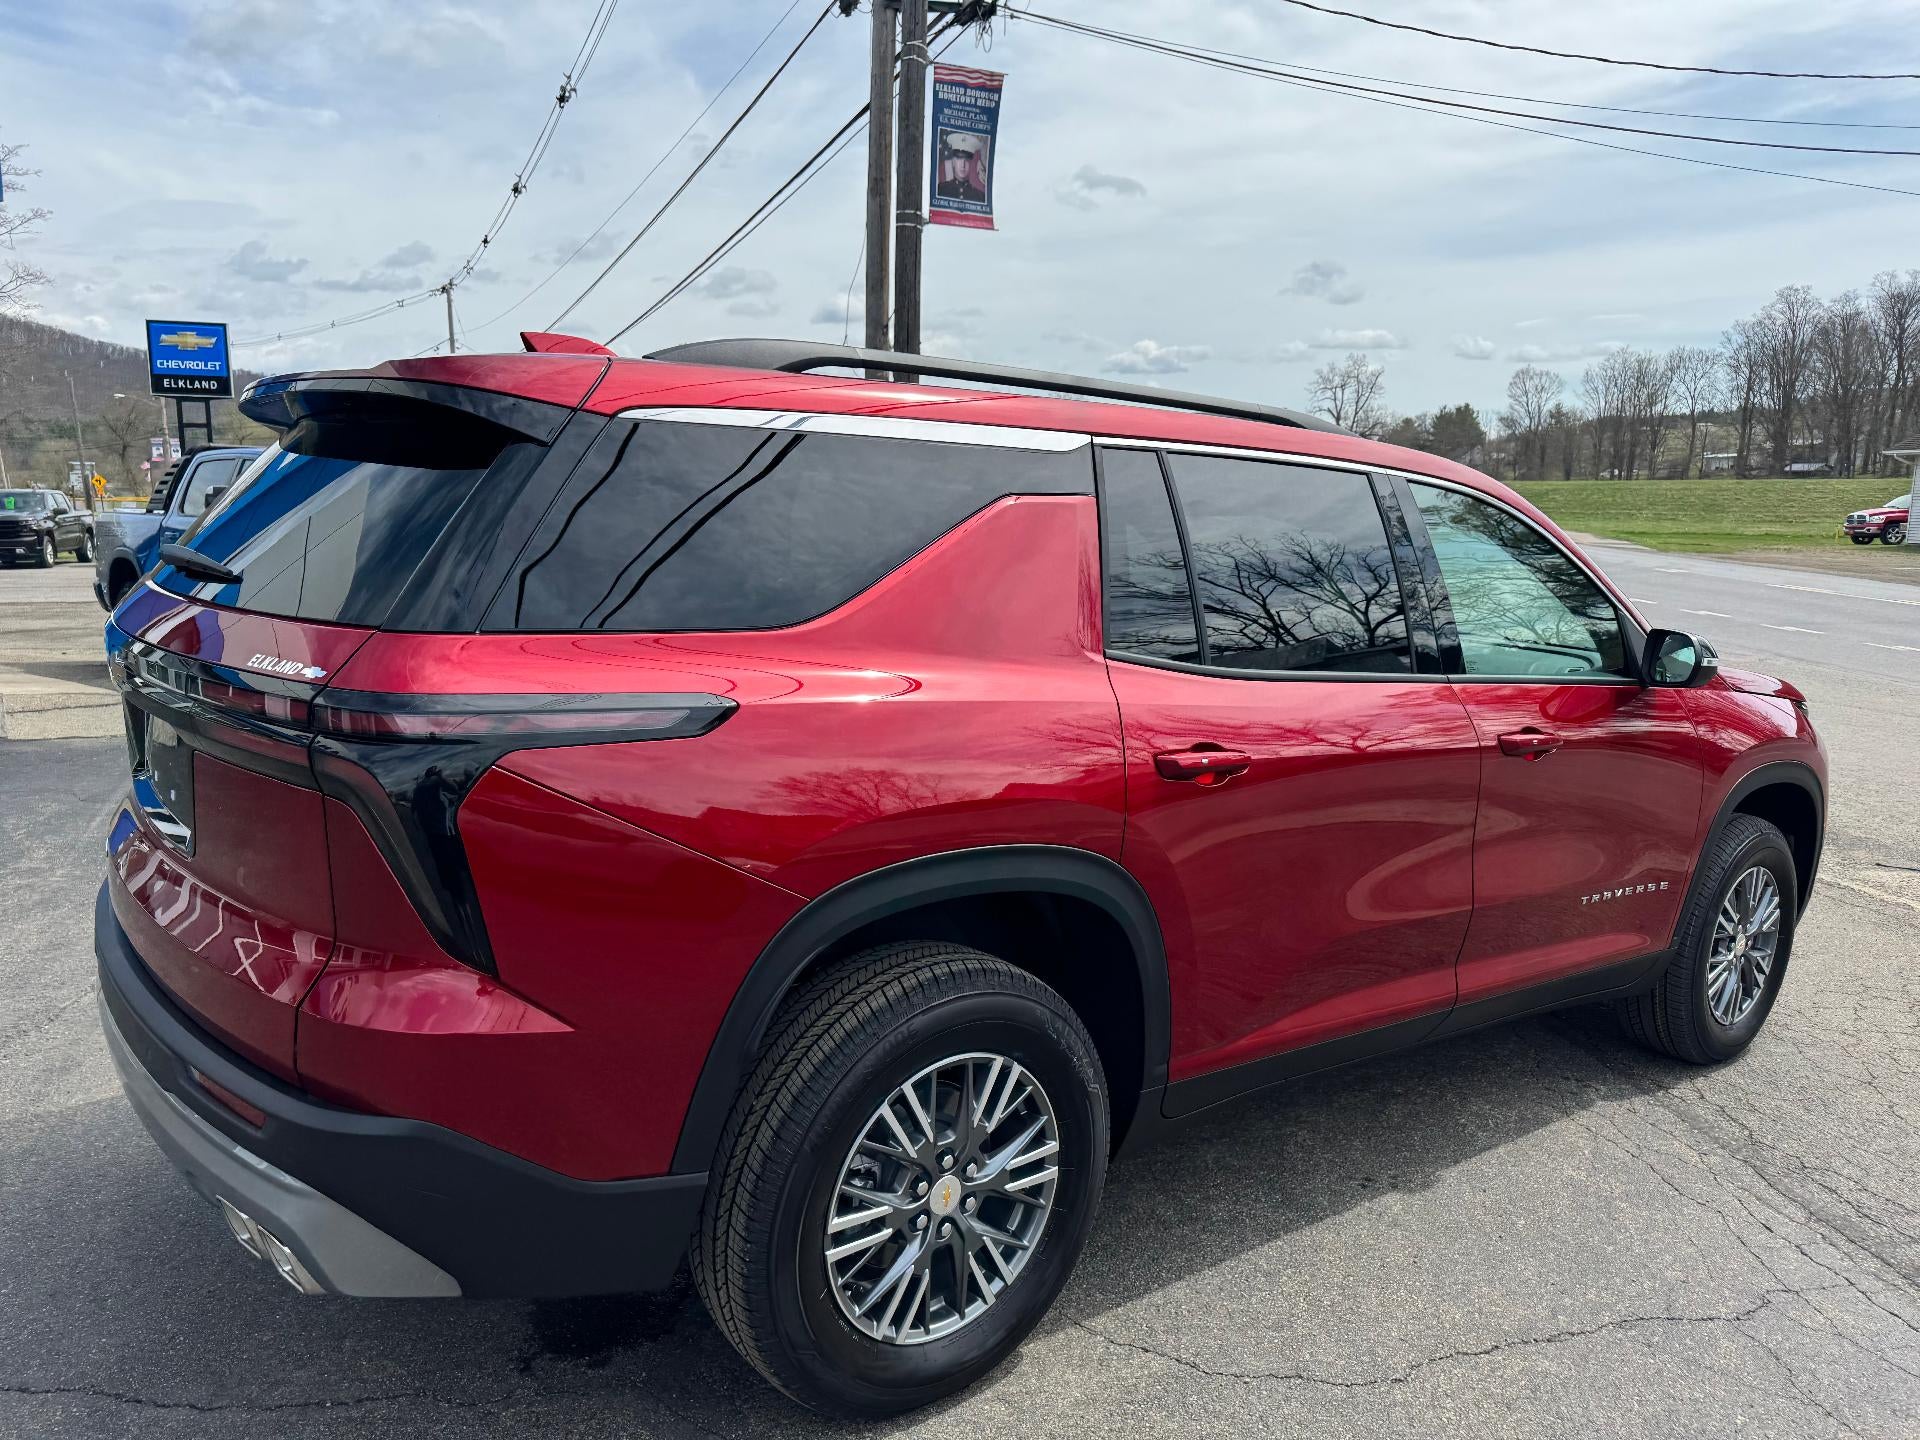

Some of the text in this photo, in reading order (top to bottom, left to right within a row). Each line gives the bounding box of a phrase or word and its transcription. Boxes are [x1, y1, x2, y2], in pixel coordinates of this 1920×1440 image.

[935, 83, 999, 101] ELKLAND BOROUGH
[938, 91, 996, 108] HOMETOWN HERO
[943, 108, 968, 119] MICHAEL
[950, 117, 971, 128] MARINE
[972, 121, 991, 131] CORPS
[156, 359, 222, 371] CHEVROLET
[163, 378, 218, 390] ELKLAND
[246, 653, 304, 675] ELKLAND
[1581, 881, 1669, 905] TRAVERSE
